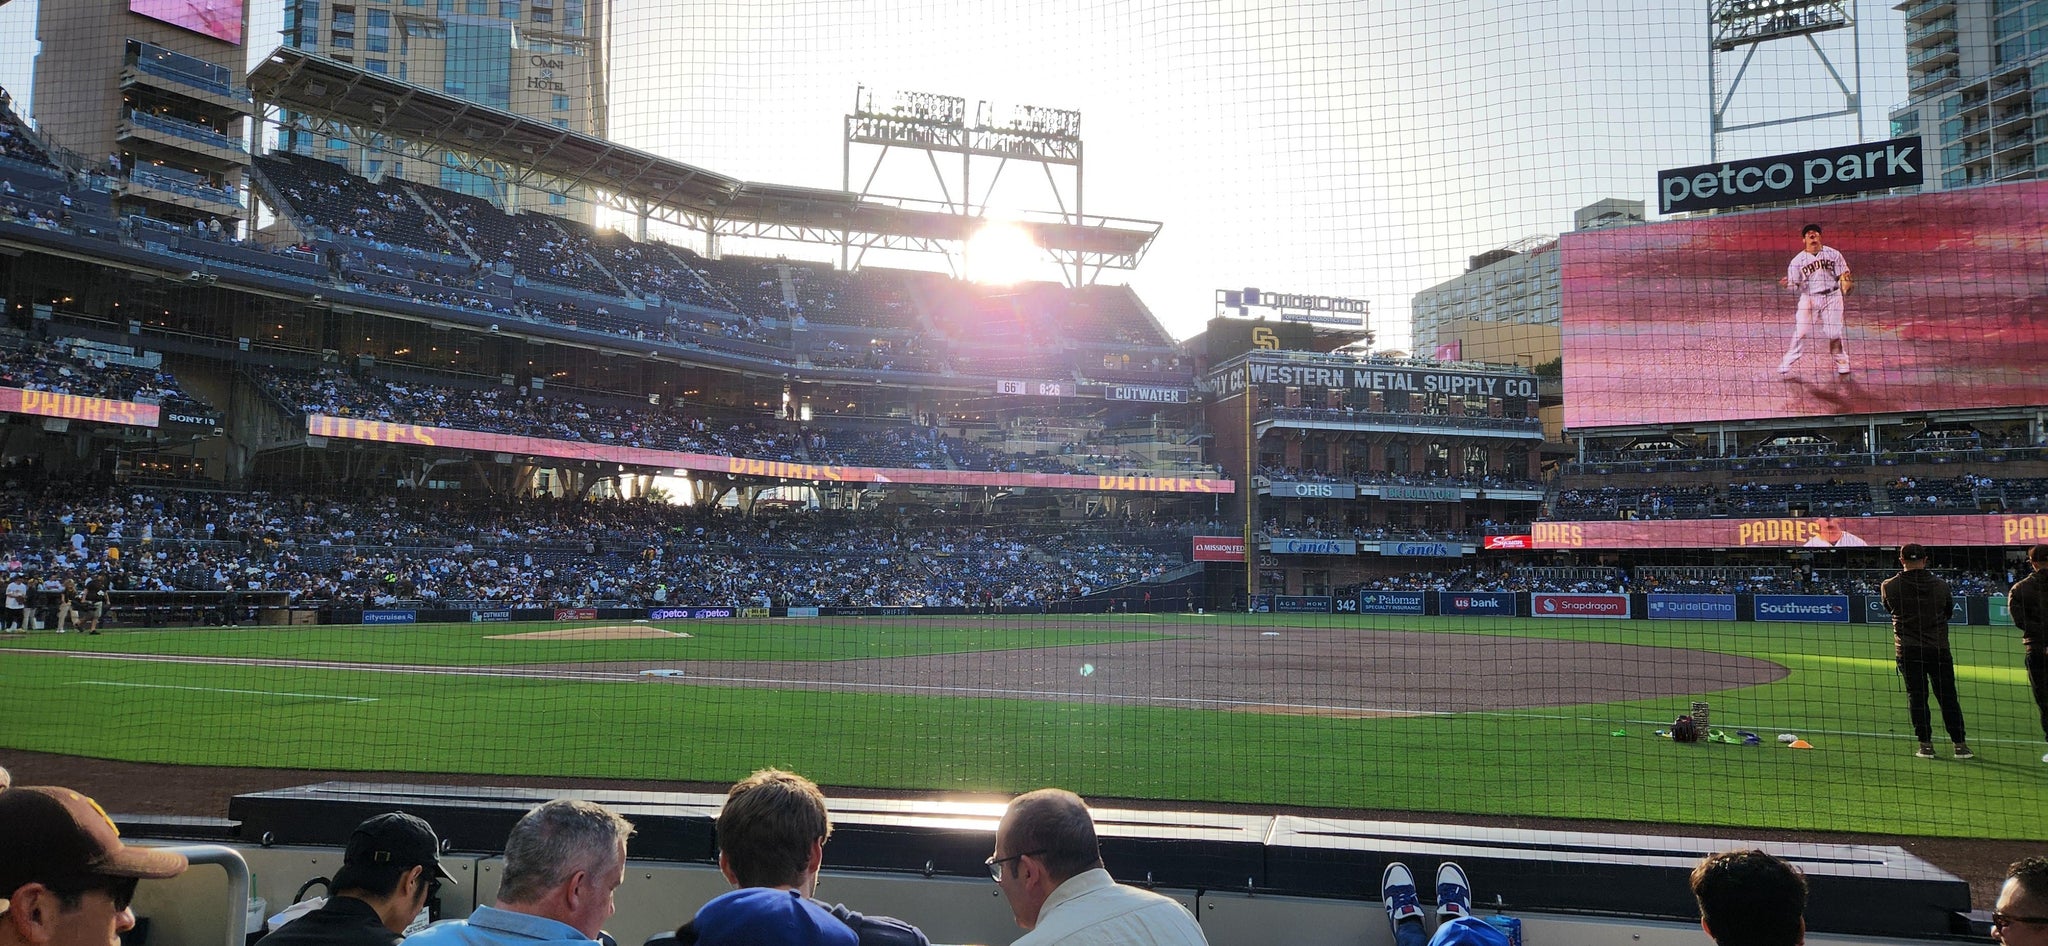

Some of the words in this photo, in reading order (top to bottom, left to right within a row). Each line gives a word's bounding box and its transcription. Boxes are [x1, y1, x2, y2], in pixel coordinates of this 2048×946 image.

[531, 55, 564, 70] OMNI
[527, 76, 566, 92] HOTEL
[1662, 162, 1794, 212] petco
[1803, 145, 1917, 195] park
[1801, 258, 1836, 276] PADRES
[1263, 292, 1364, 313] QuidelOrtho
[1250, 364, 1344, 388] WESTERN
[1354, 370, 1419, 391] METAL
[1424, 374, 1497, 396] SUPPLY
[1504, 379, 1537, 398] CO.
[1039, 383, 1060, 396] 6:26
[1116, 387, 1179, 402] CUTWATER
[168, 413, 203, 424] SONY
[1295, 484, 1332, 497] ORIS
[1532, 523, 1582, 546] DRES
[1739, 518, 1821, 546] PADRES
[1203, 544, 1232, 552] MISSION
[1287, 540, 1341, 554] Canel's
[1397, 542, 1447, 556] Canel's
[1336, 599, 1356, 611] 342
[1378, 595, 1421, 605] Palomar
[1455, 599, 1469, 608] us
[1470, 597, 1499, 608] bank
[1562, 601, 1618, 611] Snapdragon
[1668, 601, 1732, 612] QuidelOrtho
[662, 609, 688, 619] petco
[705, 608, 729, 618] petco
[1760, 602, 1834, 614] Southwest
[364, 613, 406, 623] citycruises
